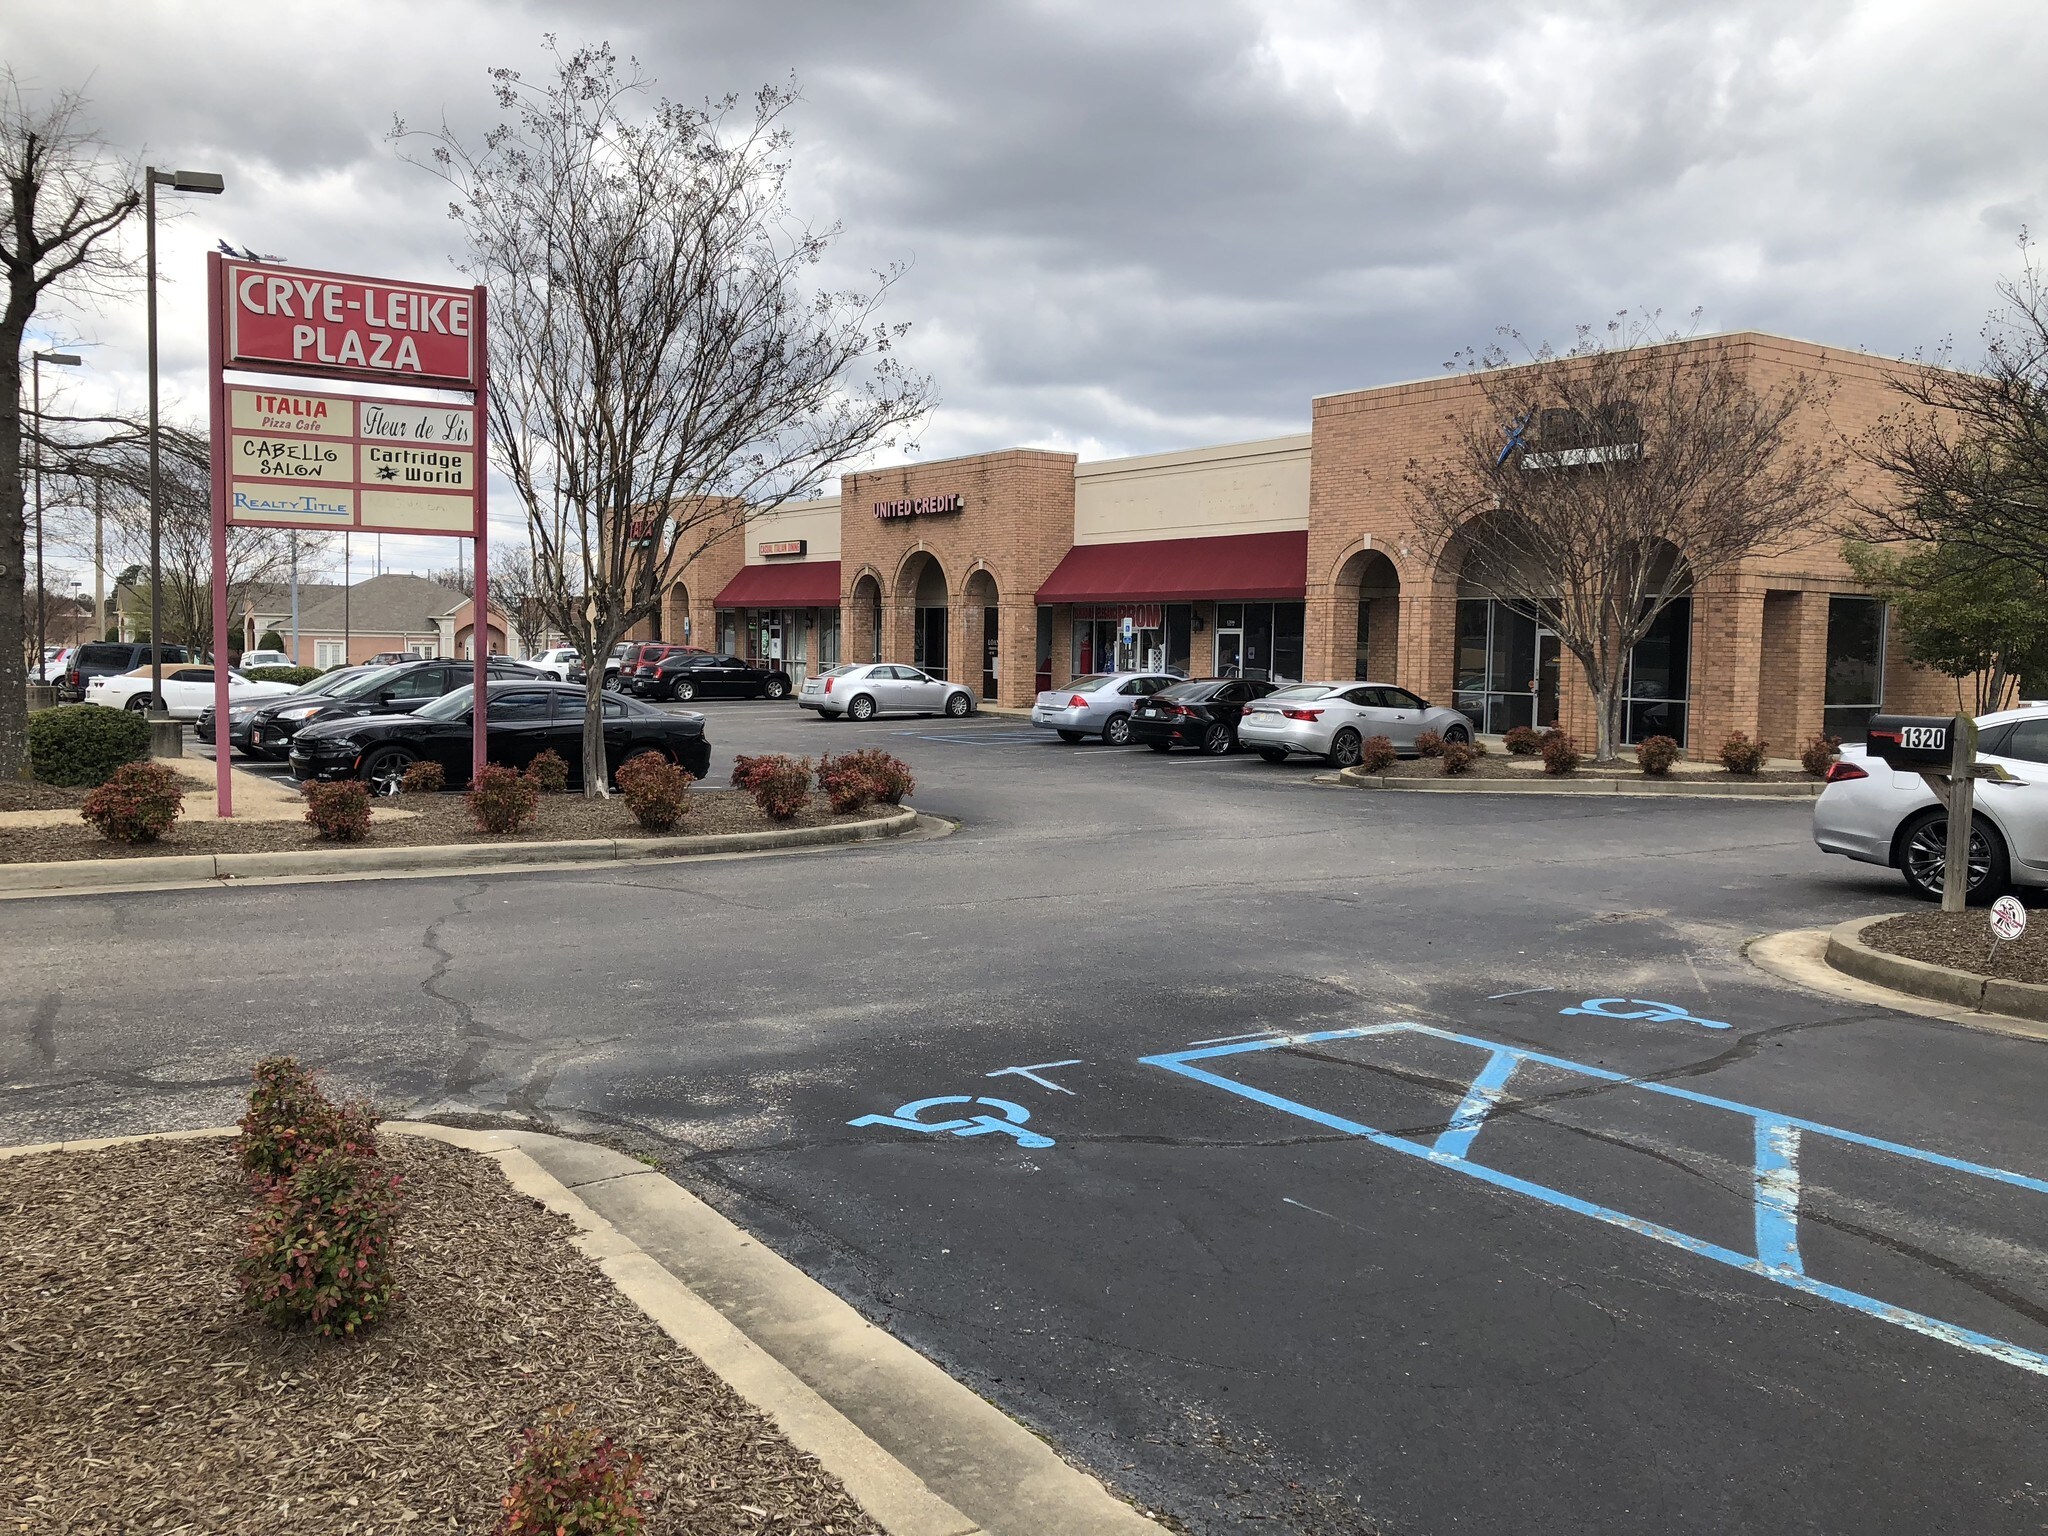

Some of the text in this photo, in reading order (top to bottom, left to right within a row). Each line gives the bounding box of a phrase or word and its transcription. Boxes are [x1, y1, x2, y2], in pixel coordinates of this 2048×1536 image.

[239, 275, 468, 336] CRYE-LEIKE
[293, 324, 422, 371] PLAZA
[256, 395, 327, 418] ITALIA
[262, 416, 321, 431] Pizza Cafe
[364, 406, 468, 442] Fleur de Lis
[243, 440, 337, 462] CABELLO
[370, 447, 462, 469] Cartridge
[260, 459, 322, 476] SALON
[405, 467, 462, 484] World
[872, 493, 956, 519] UNITED CREDIT
[1117, 604, 1161, 628] PROM
[1904, 728, 1944, 748] 1320
